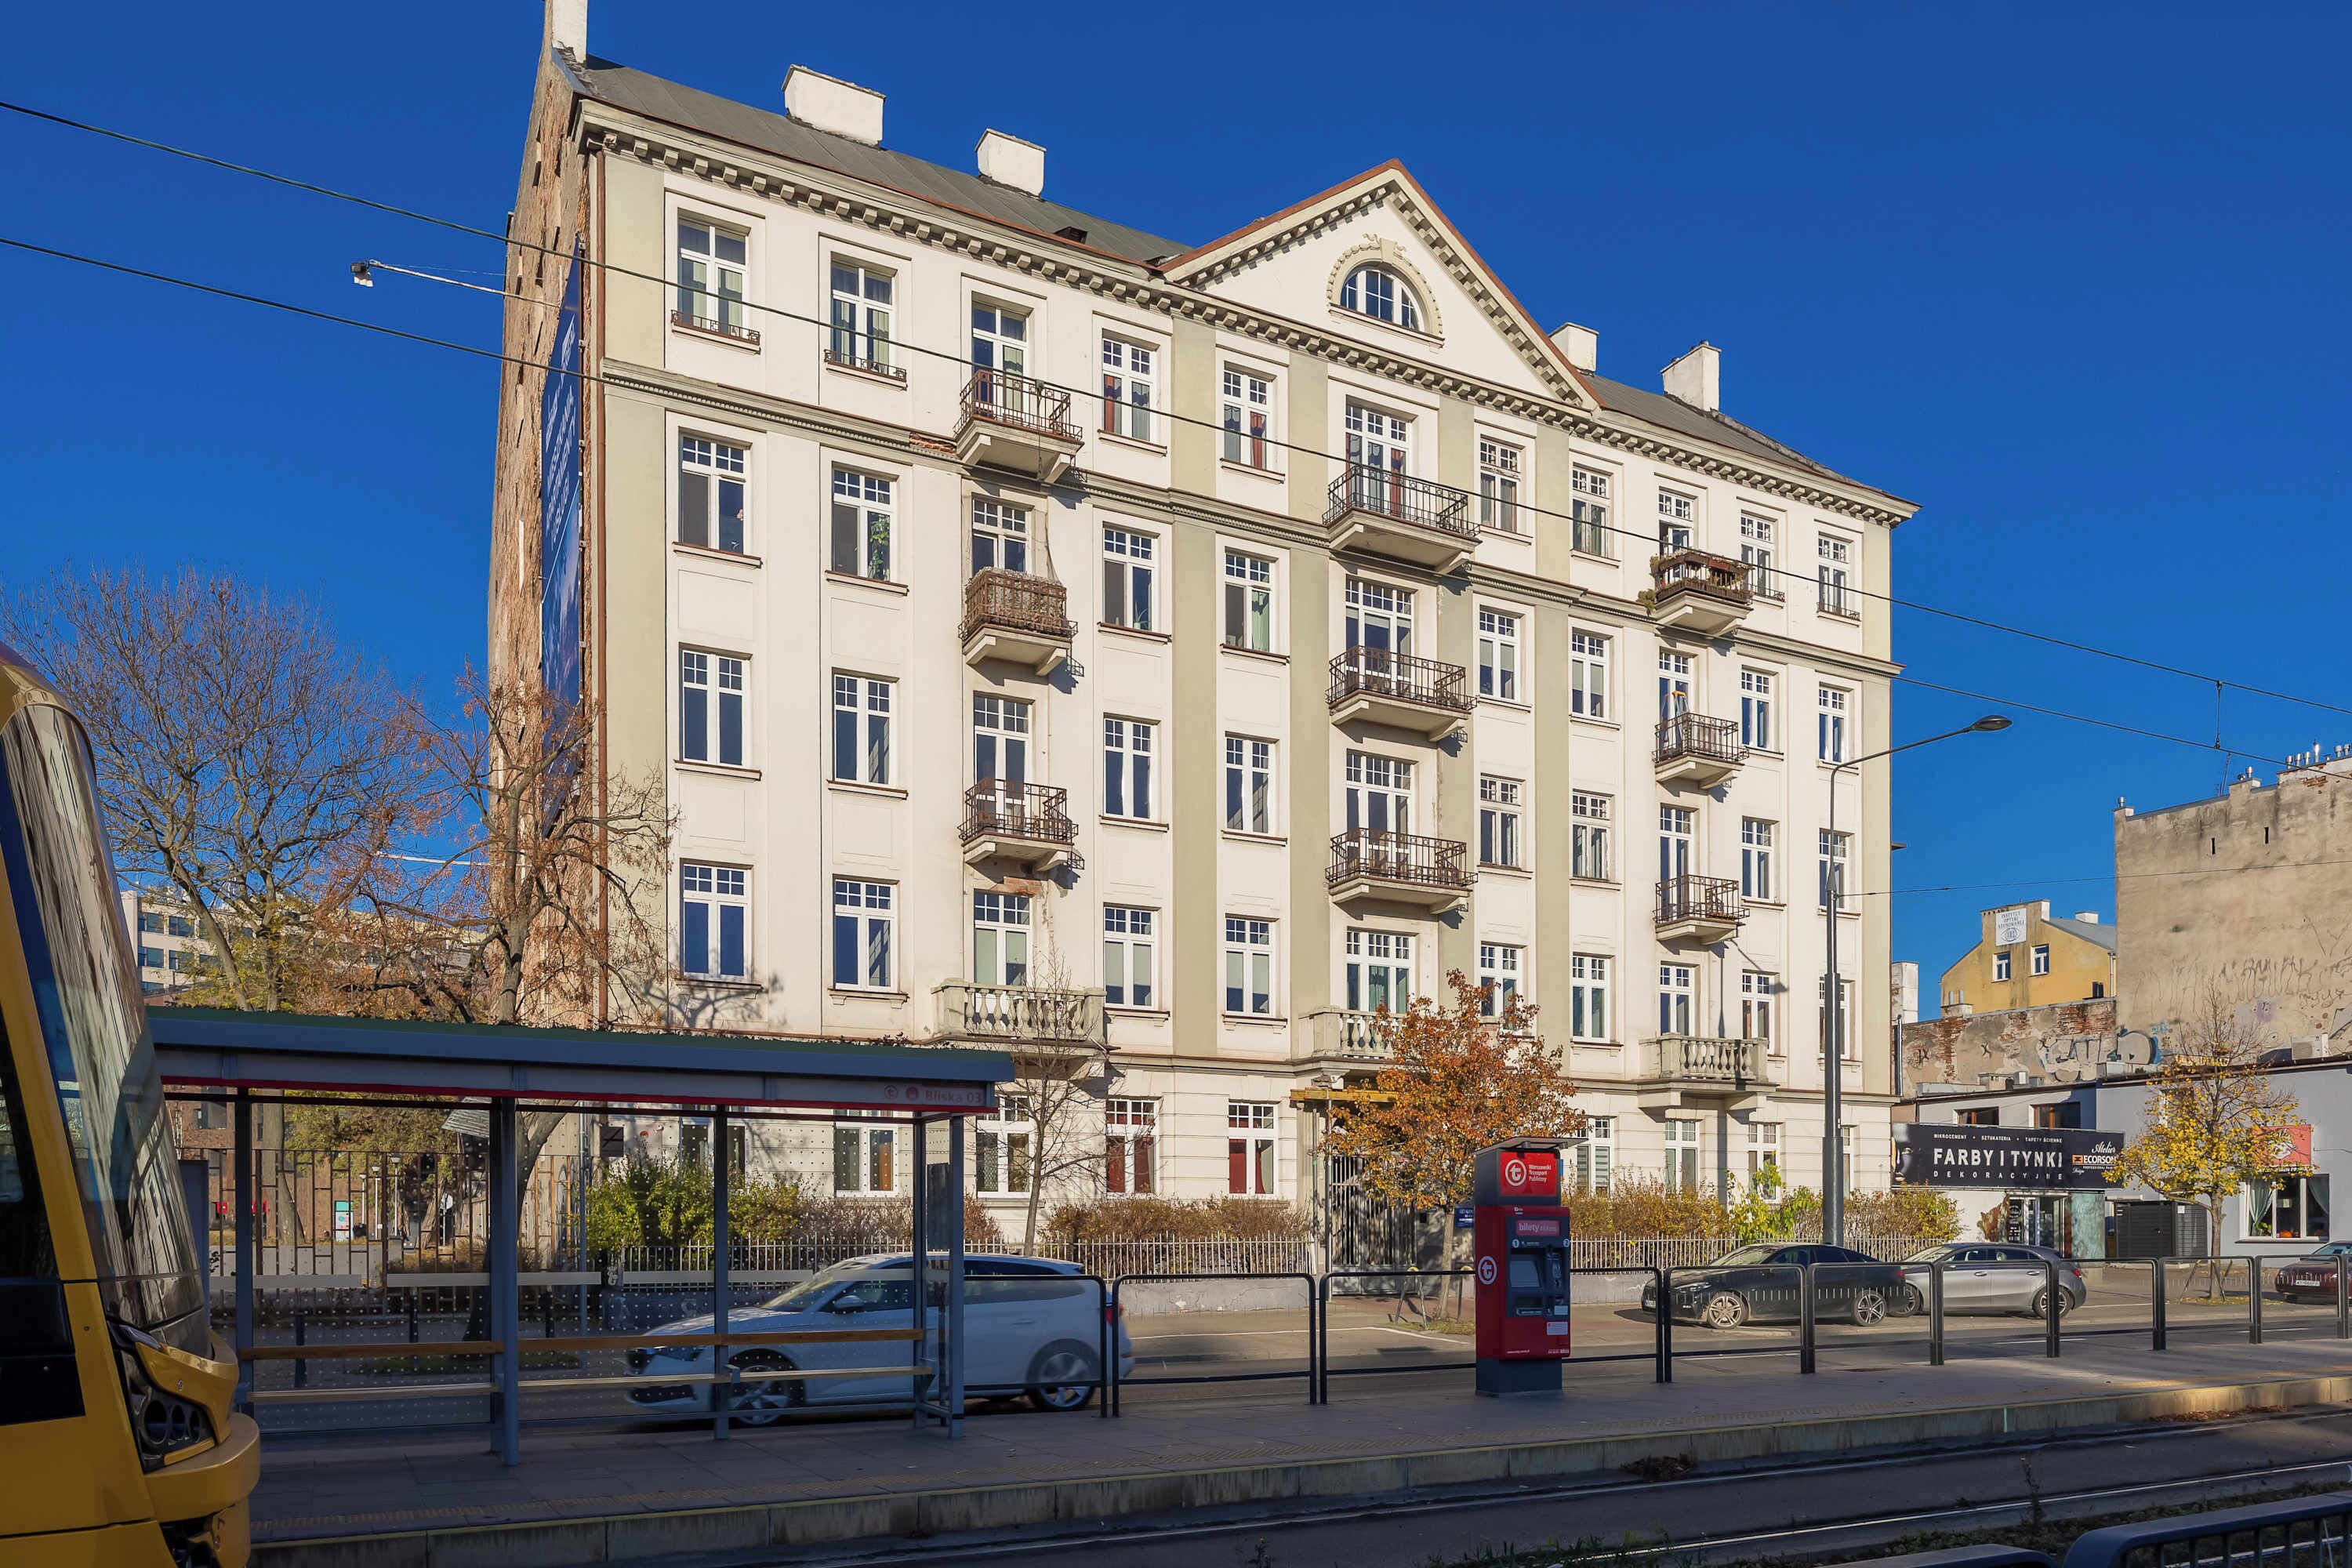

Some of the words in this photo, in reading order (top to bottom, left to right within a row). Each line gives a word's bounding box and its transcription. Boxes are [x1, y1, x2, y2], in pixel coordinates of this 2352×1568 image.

[1933, 1148, 1994, 1167] FARBY
[2000, 1149, 2005, 1167] I
[2010, 1150, 2063, 1168] TYNKI
[1933, 1171, 2063, 1180] DEKORACYJNE
[1518, 1223, 1539, 1233] bilety
